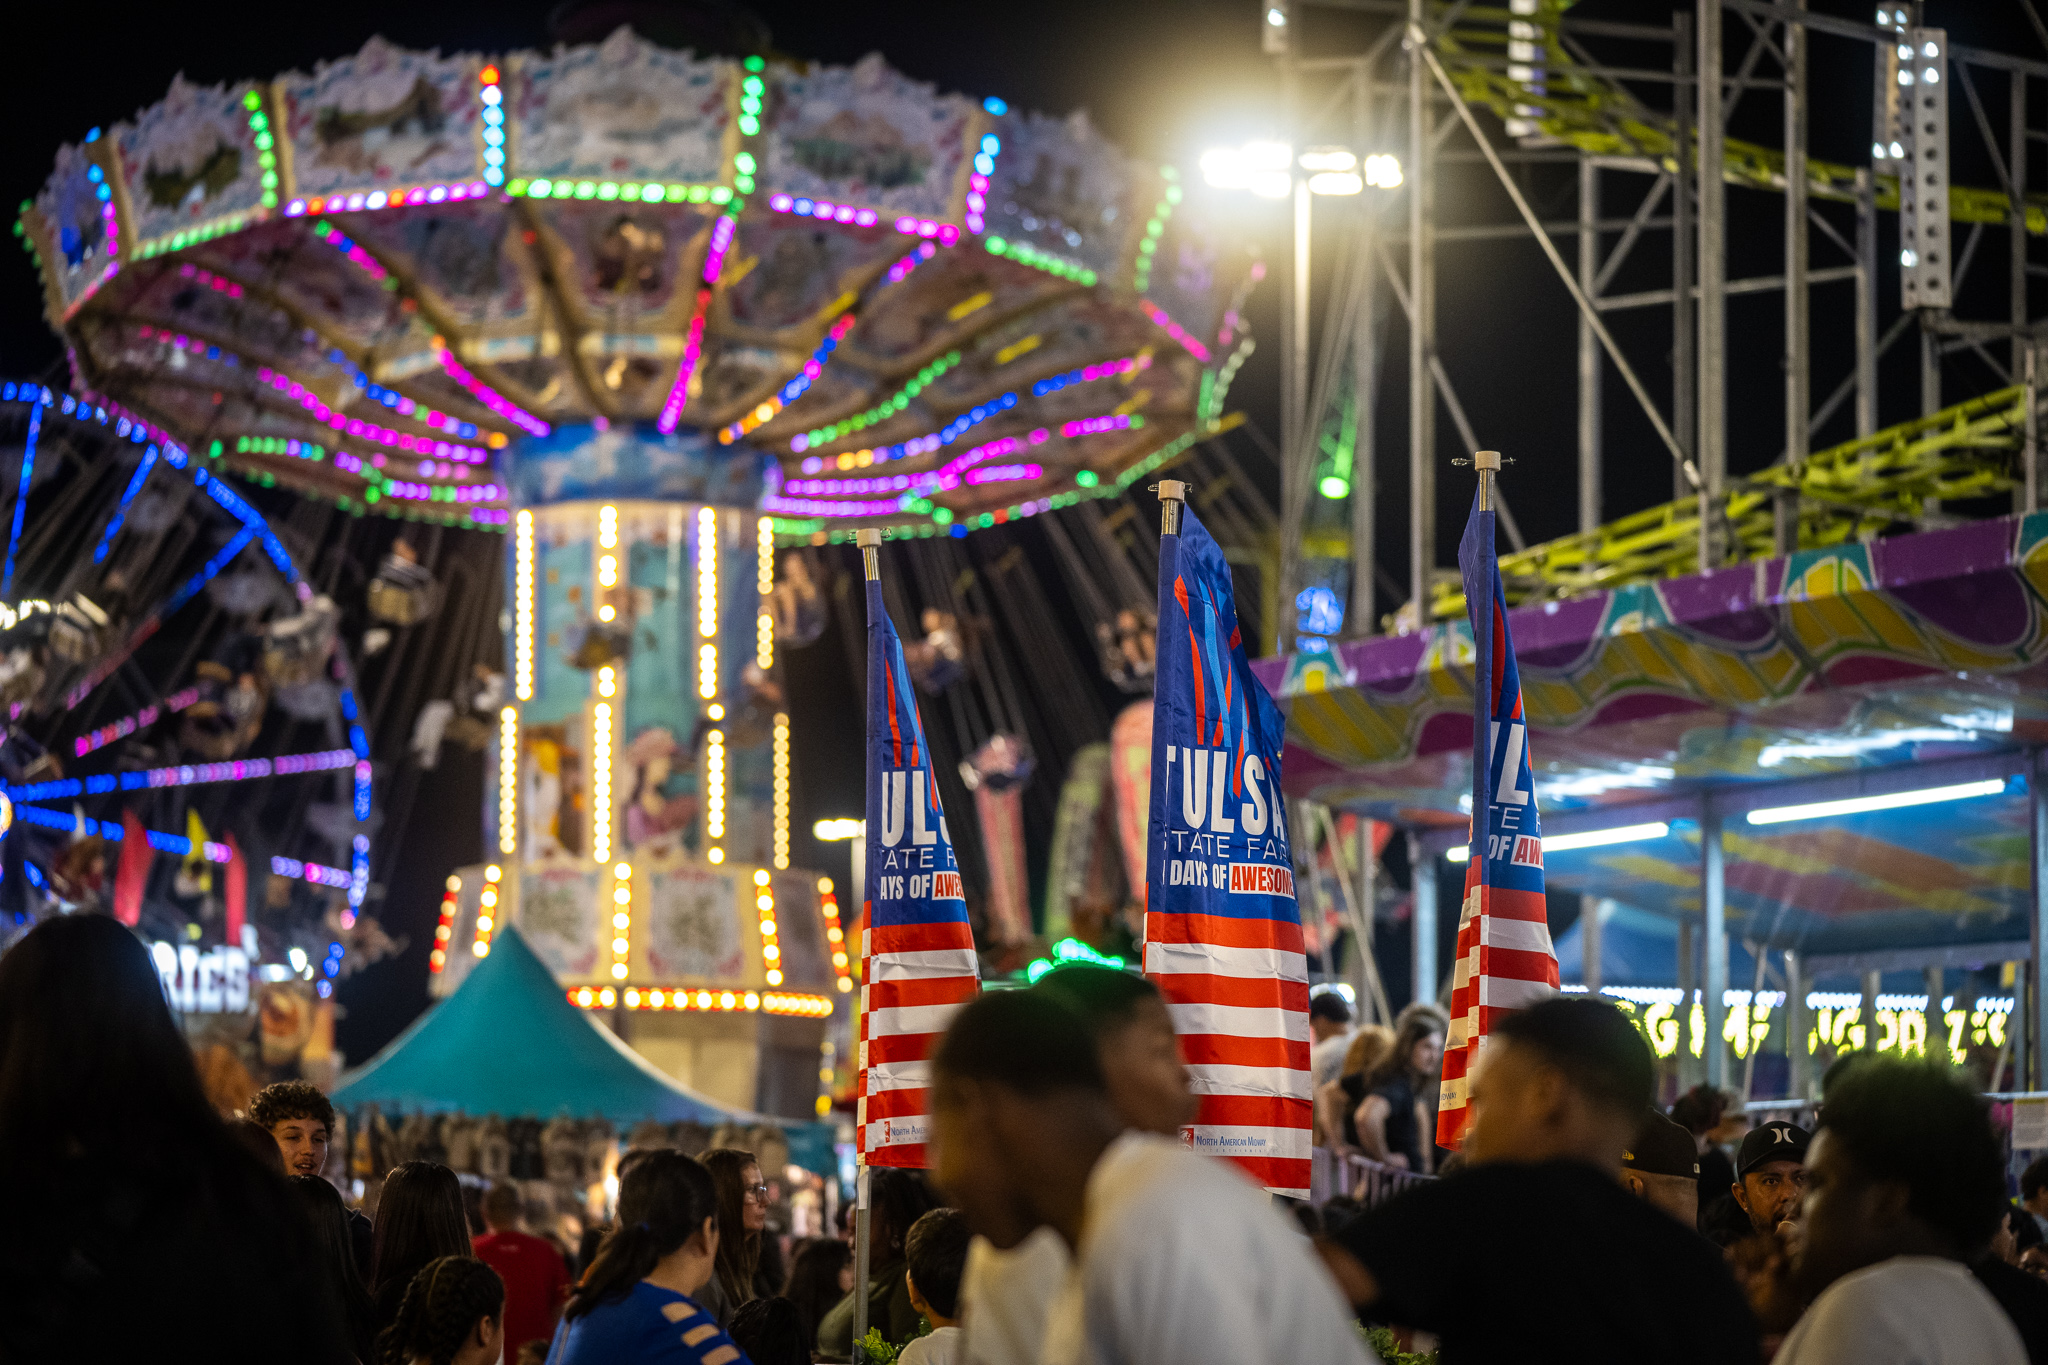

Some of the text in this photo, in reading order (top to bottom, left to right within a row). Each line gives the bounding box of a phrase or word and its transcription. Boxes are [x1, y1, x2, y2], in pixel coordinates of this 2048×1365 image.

[1163, 822, 1231, 859] TATE
[1514, 837, 1544, 867] AW
[882, 847, 934, 869] ATE
[909, 874, 931, 899] OF
[1169, 859, 1208, 888] DAYS
[1212, 863, 1227, 890] OF
[1196, 1135, 1218, 1146] NORTH
[1219, 1135, 1247, 1147] AMERICAN
